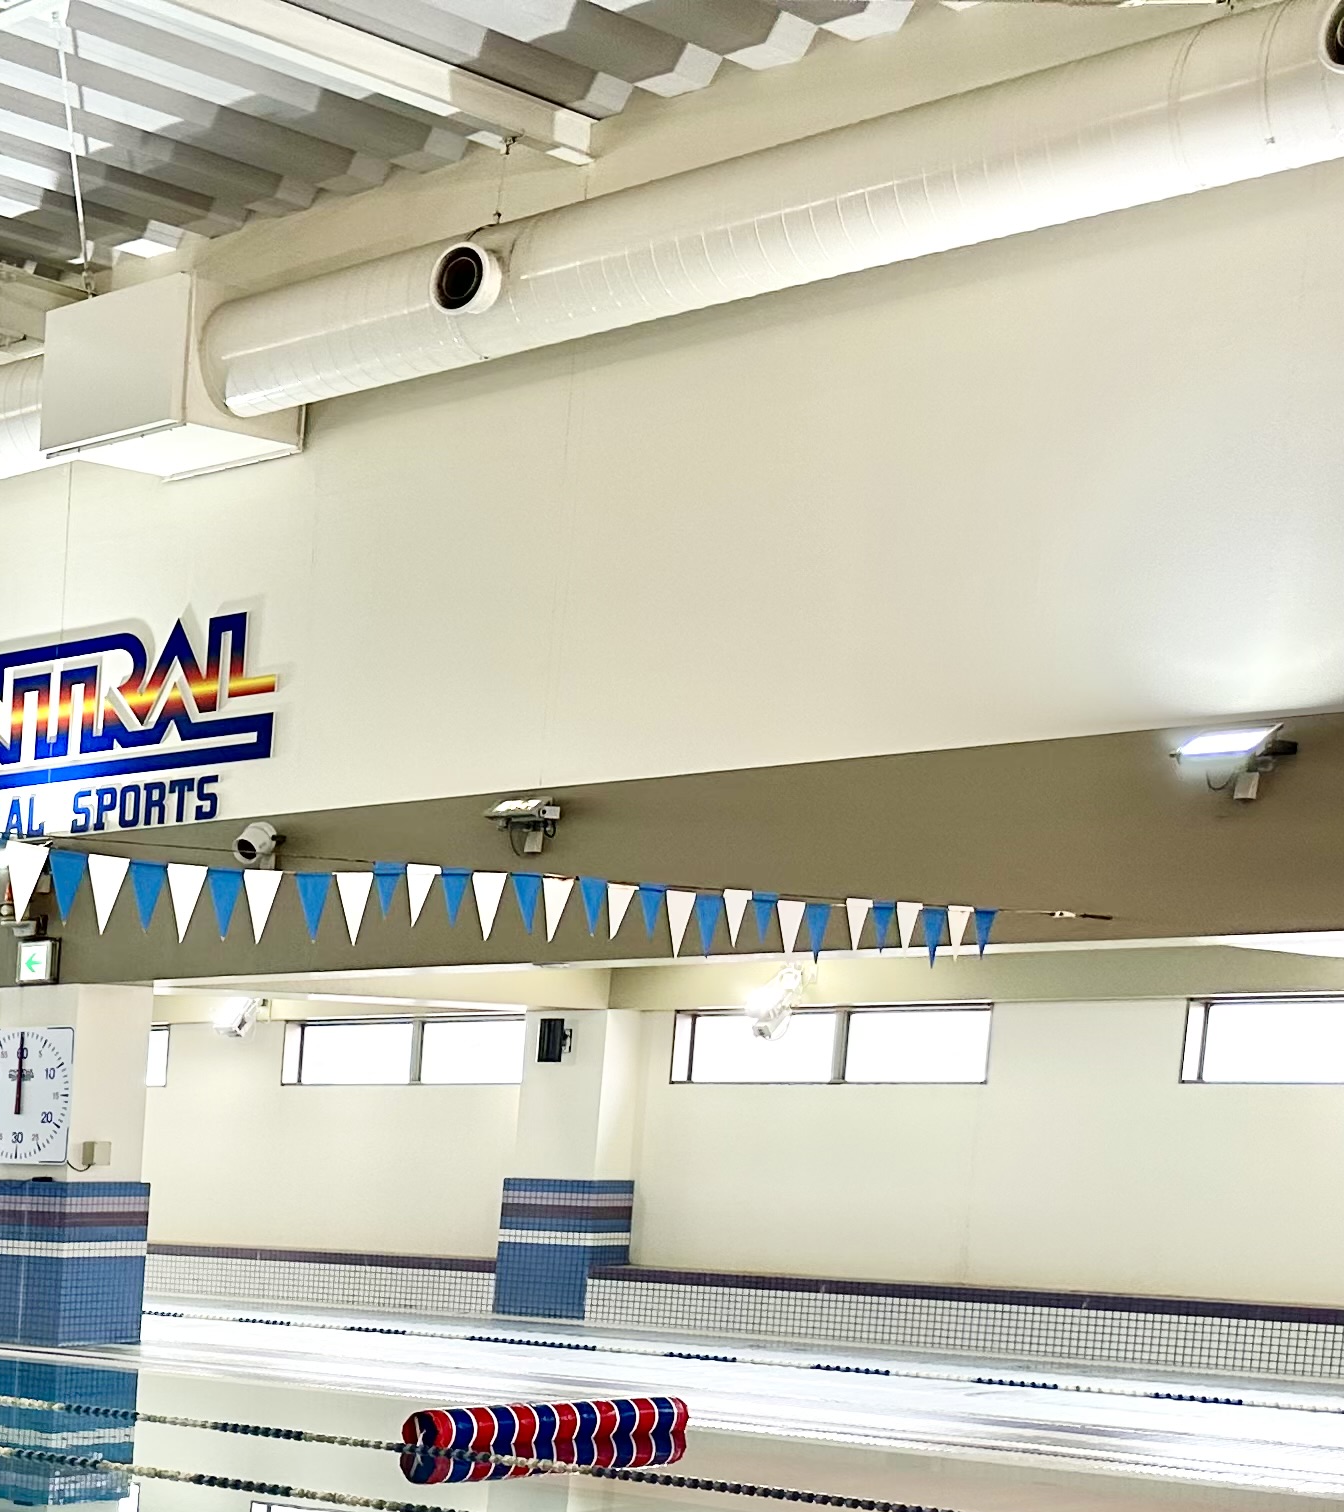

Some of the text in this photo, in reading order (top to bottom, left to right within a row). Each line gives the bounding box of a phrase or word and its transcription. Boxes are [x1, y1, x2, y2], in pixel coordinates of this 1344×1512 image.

[70, 775, 219, 834] SPORTS
[45, 1067, 56, 1080] 10
[40, 1111, 53, 1124] 20
[11, 1131, 24, 1144] 30
